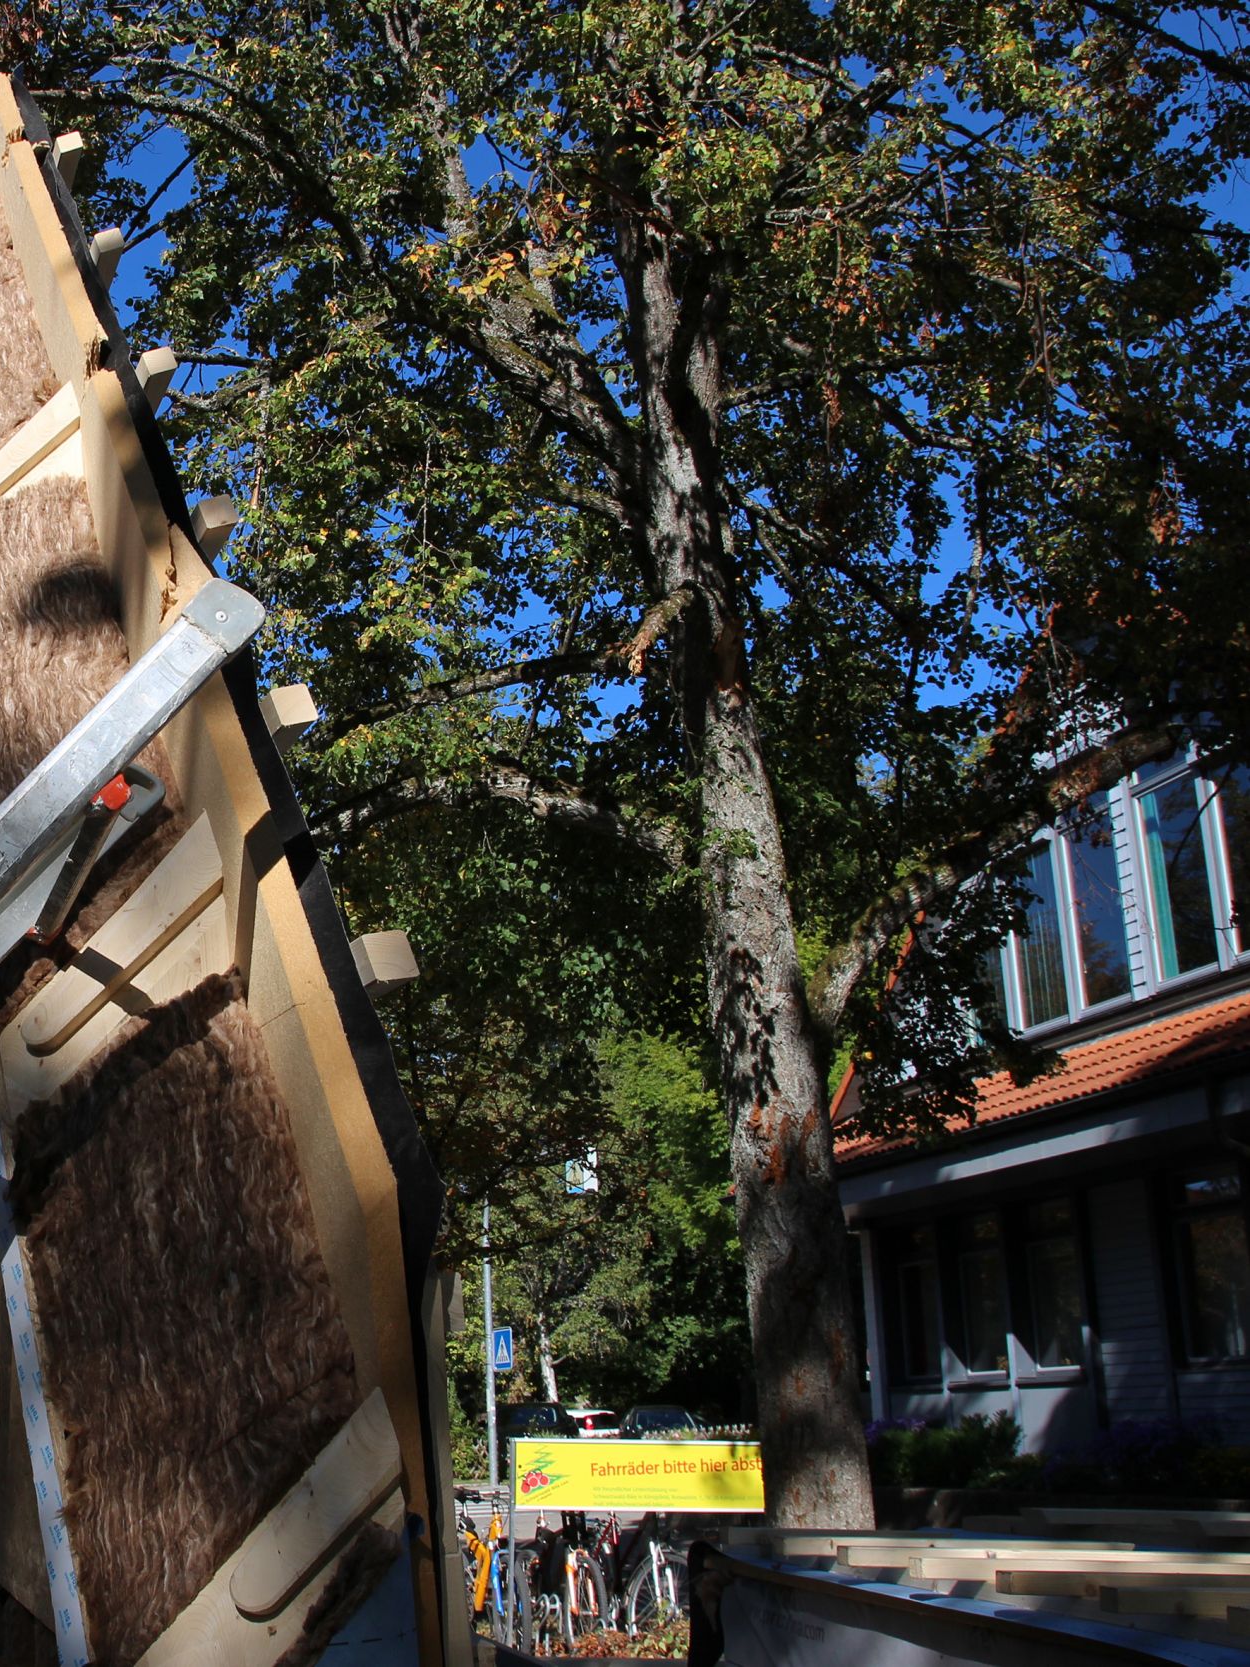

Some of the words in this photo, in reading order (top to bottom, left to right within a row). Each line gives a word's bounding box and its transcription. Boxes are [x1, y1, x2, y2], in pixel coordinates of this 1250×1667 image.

[590, 1461, 660, 1477] Fahrräder
[663, 1460, 697, 1474] bitte
[700, 1459, 728, 1472] hier
